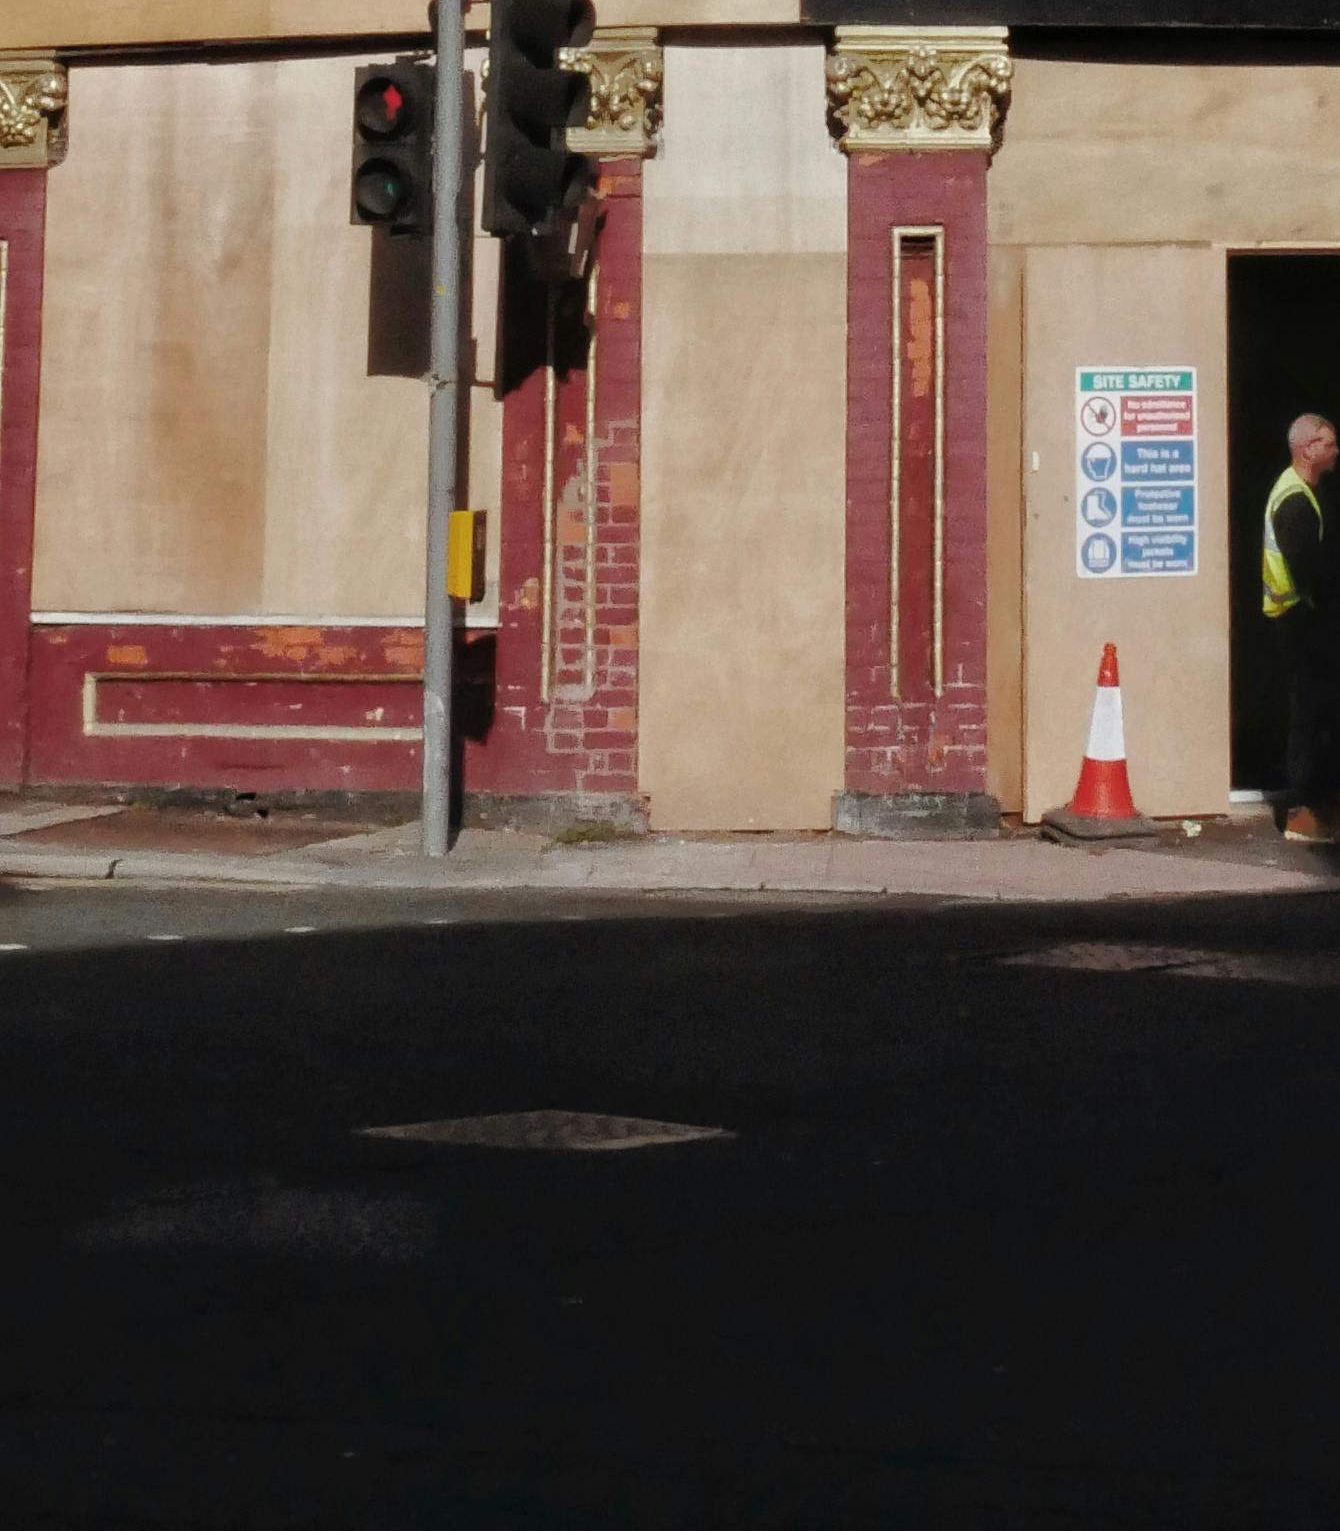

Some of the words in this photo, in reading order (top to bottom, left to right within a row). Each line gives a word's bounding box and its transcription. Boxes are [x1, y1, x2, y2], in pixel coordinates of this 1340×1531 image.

[1093, 374, 1125, 389] SITE
[1128, 373, 1181, 389] SAFETY
[1137, 447, 1159, 459] This
[1124, 462, 1148, 474] hard
